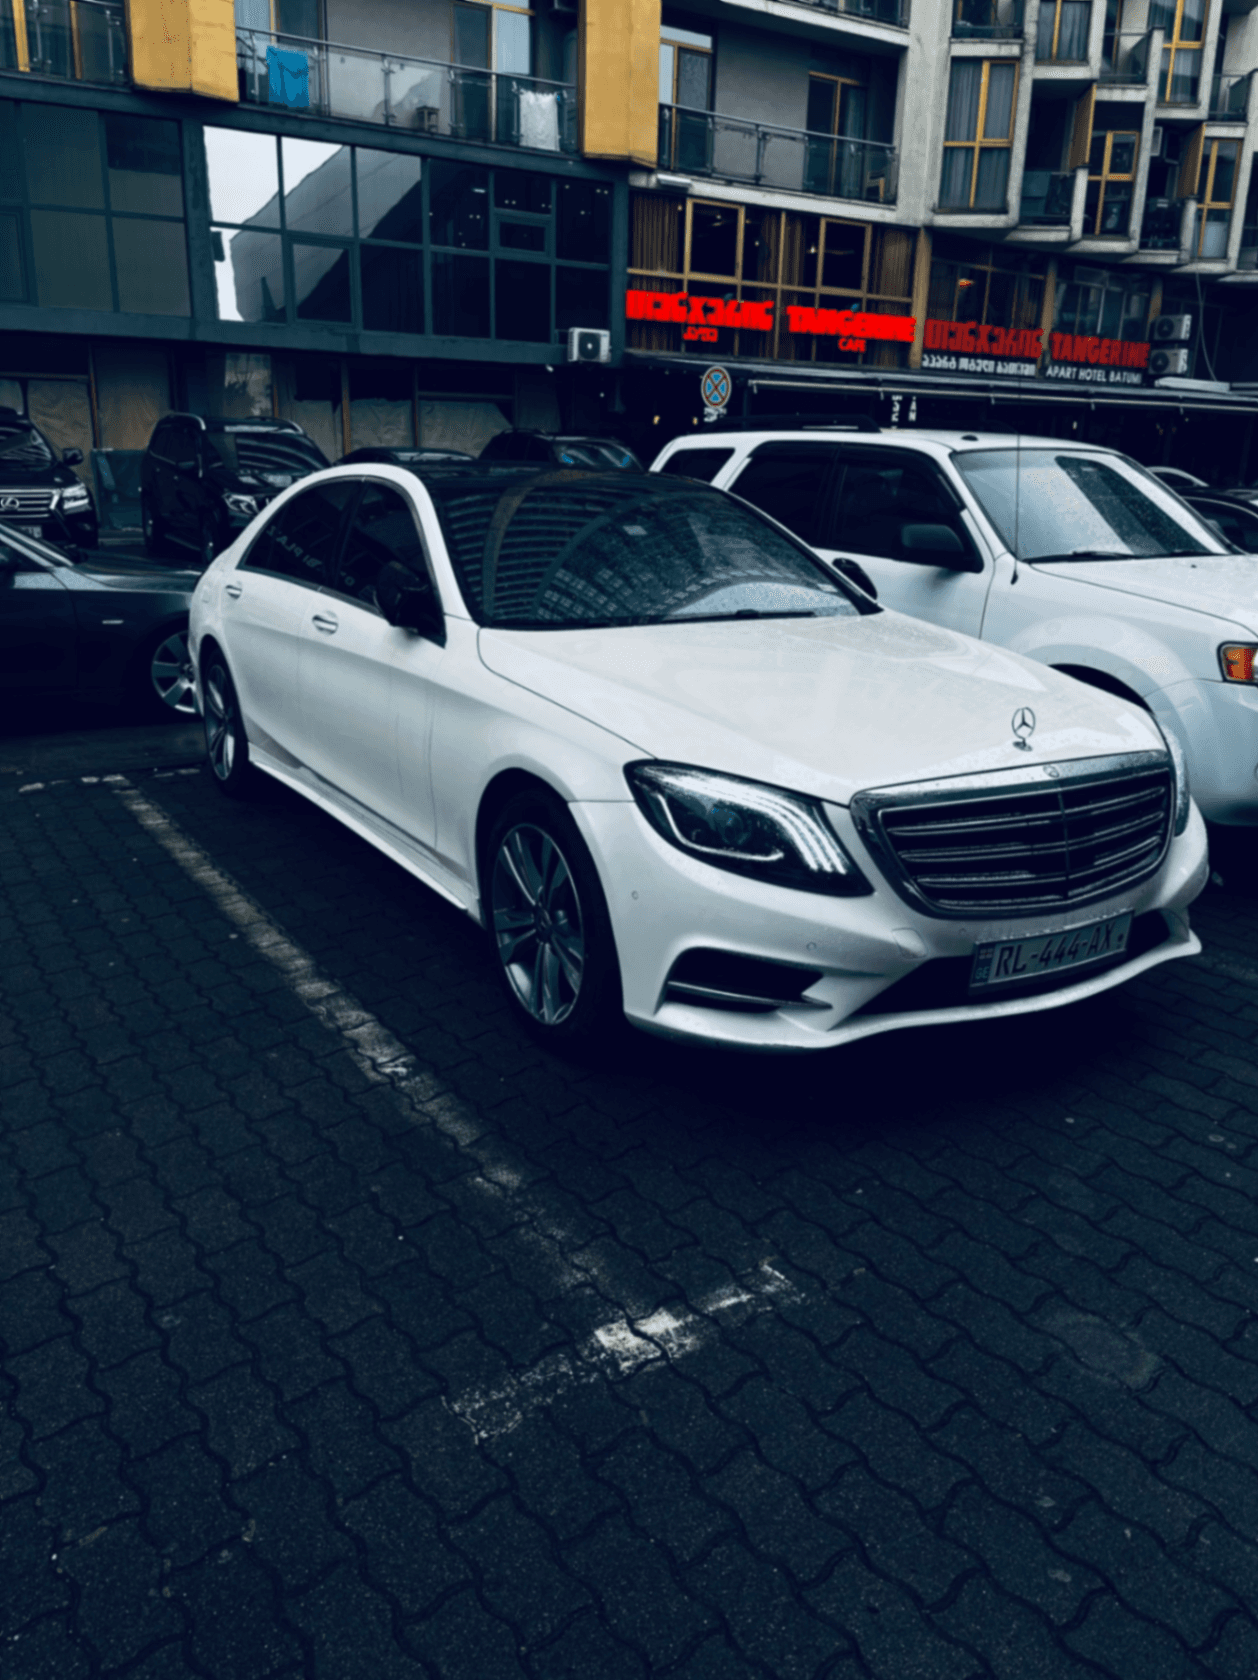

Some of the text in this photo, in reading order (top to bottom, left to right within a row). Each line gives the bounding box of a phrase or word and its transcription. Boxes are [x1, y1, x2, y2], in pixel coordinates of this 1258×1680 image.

[786, 305, 916, 342] TANGERINE
[838, 338, 867, 353] CAFE
[1051, 332, 1151, 368] TANGERINE
[1045, 365, 1142, 385] APART HOTEL BATUMI
[994, 922, 1116, 977] RL-444-AX
